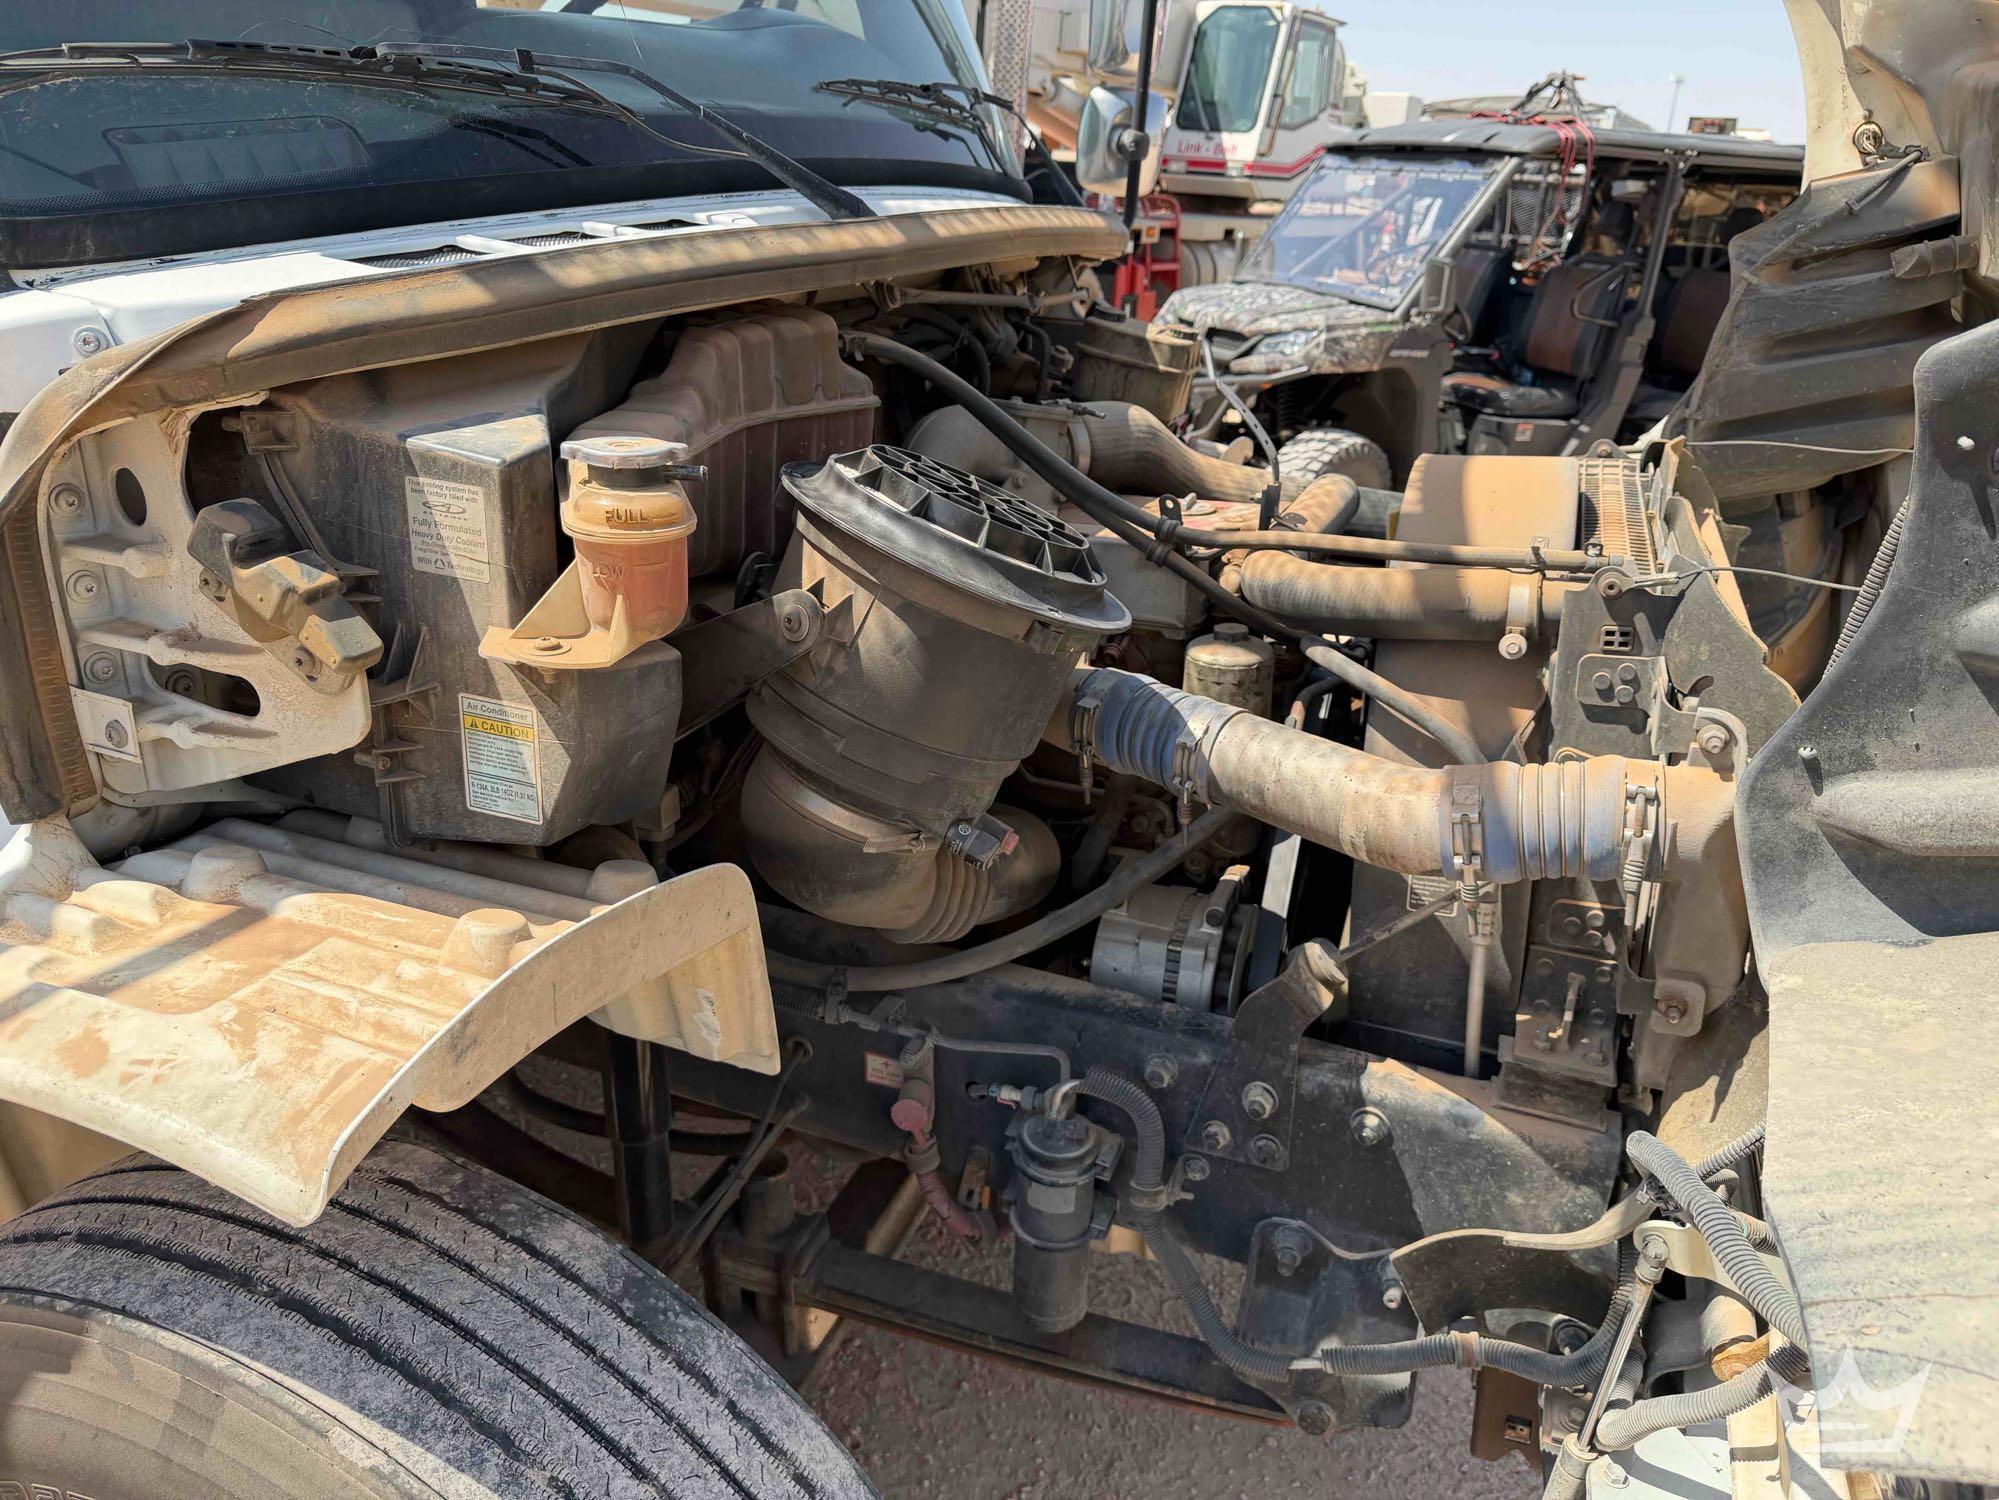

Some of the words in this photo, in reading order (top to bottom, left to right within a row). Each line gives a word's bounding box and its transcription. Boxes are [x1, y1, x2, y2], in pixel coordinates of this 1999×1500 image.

[467, 488, 479, 496] has
[605, 508, 648, 523] FULL
[412, 516, 432, 529] Fully
[434, 520, 481, 536] Formulated
[411, 528, 434, 540] Heavy
[435, 533, 454, 544] Duty
[455, 536, 485, 548] Coolant
[417, 556, 433, 565] With
[446, 561, 485, 576] Technology
[593, 563, 625, 578] LOW
[466, 701, 479, 711] Air
[480, 704, 529, 721] Conditioner
[481, 721, 529, 739] CAUTION
